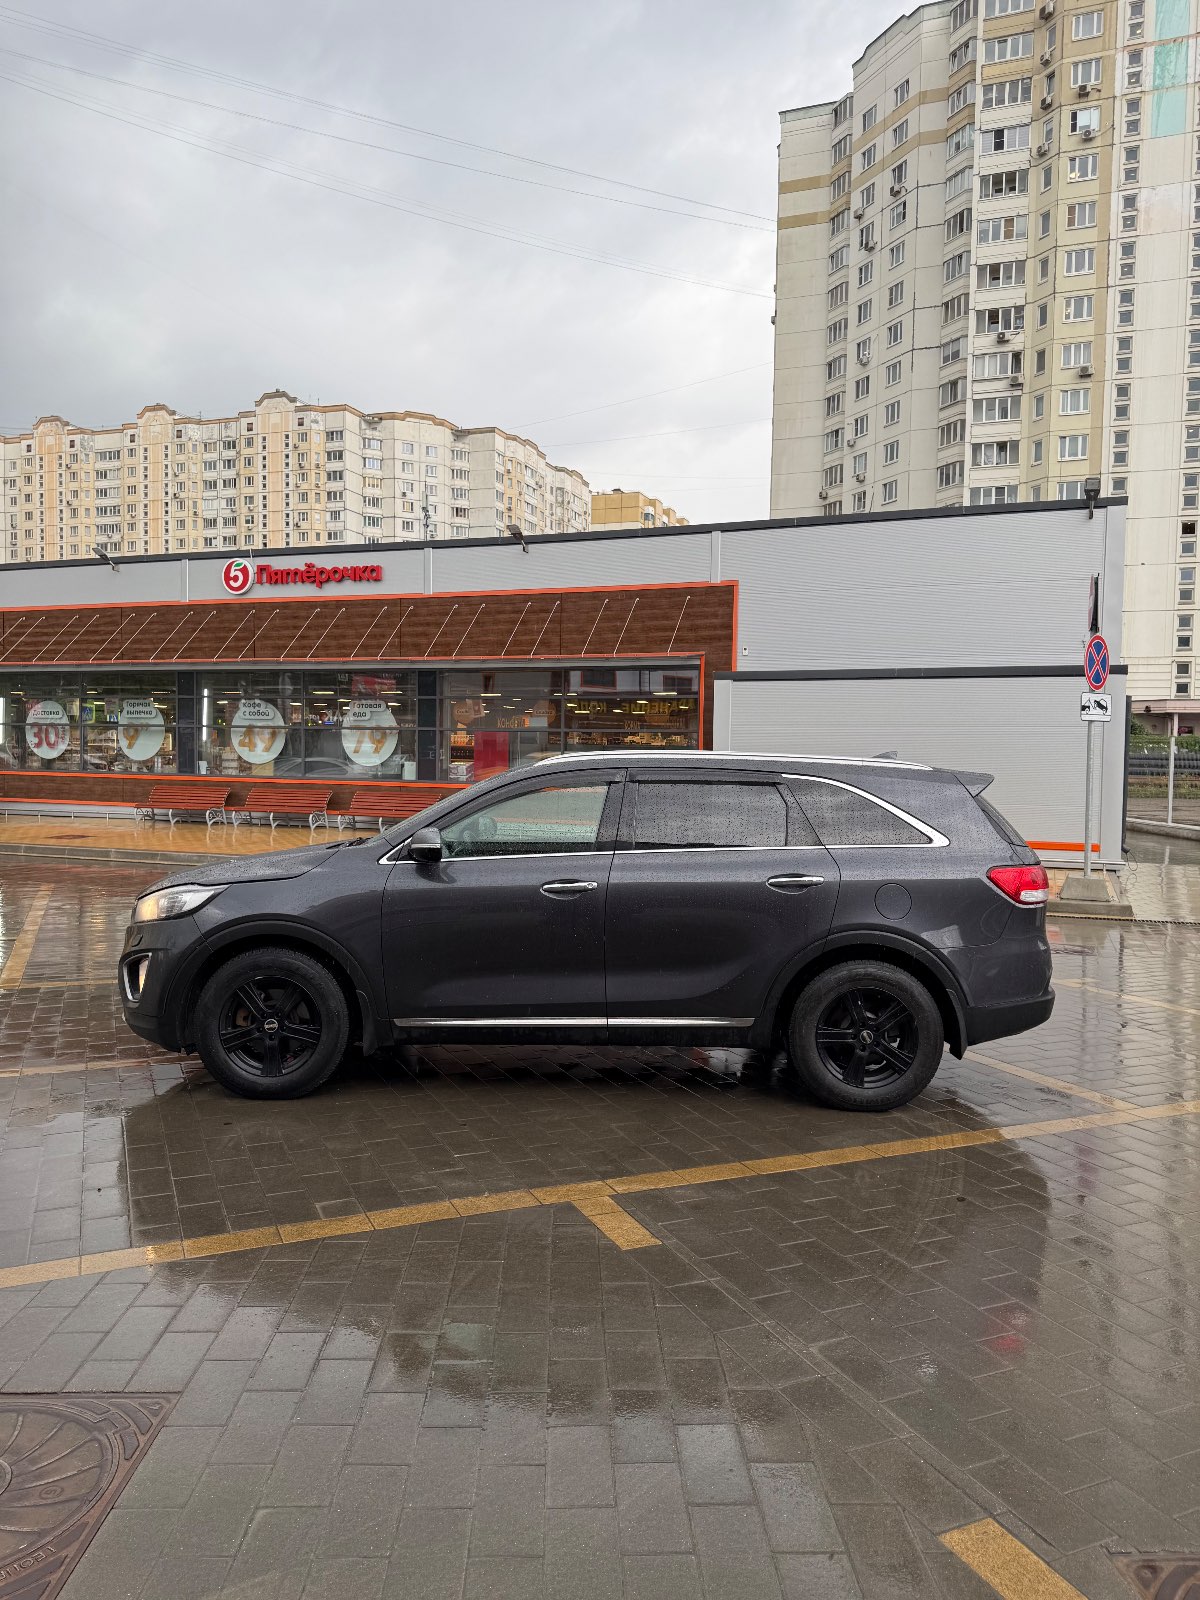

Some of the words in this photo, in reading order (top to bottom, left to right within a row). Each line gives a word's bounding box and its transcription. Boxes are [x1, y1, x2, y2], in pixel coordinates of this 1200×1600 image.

[229, 561, 244, 588] 5
[256, 563, 383, 588] Пятёрочка
[32, 709, 60, 717] Доставка
[248, 709, 270, 717] собой
[31, 722, 60, 749] 30
[238, 723, 278, 752] 49
[350, 724, 387, 754] 79
